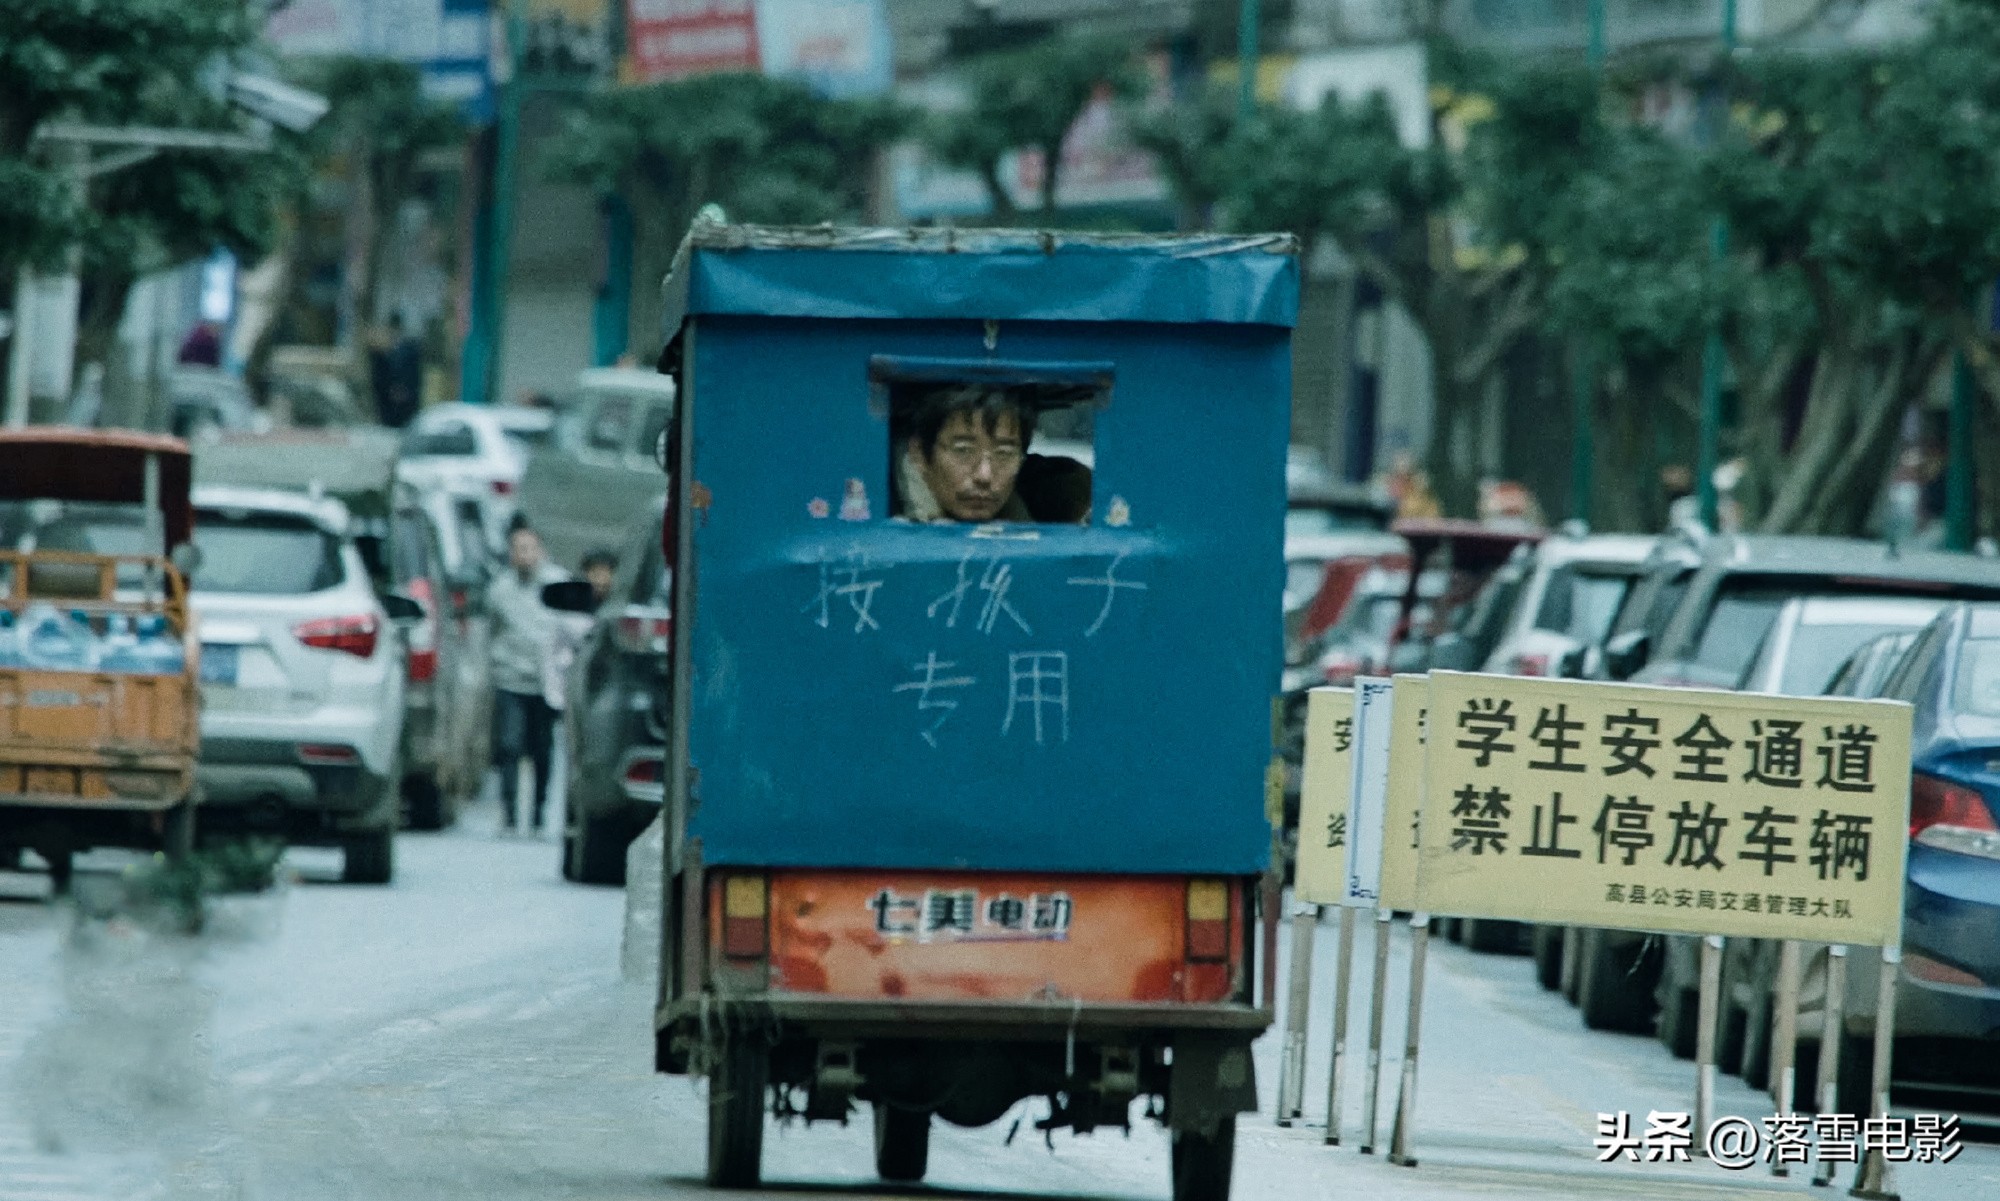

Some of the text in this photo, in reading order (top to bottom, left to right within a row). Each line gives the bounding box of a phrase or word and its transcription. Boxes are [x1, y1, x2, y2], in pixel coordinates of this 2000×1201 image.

[800, 546, 1148, 637] 接孩子
[892, 651, 1069, 748] 专用
[1456, 697, 1879, 794] 学生安全通道
[1450, 783, 1875, 882] 禁止停放车辆
[1604, 883, 1853, 918] 高县公安局交通管理大队
